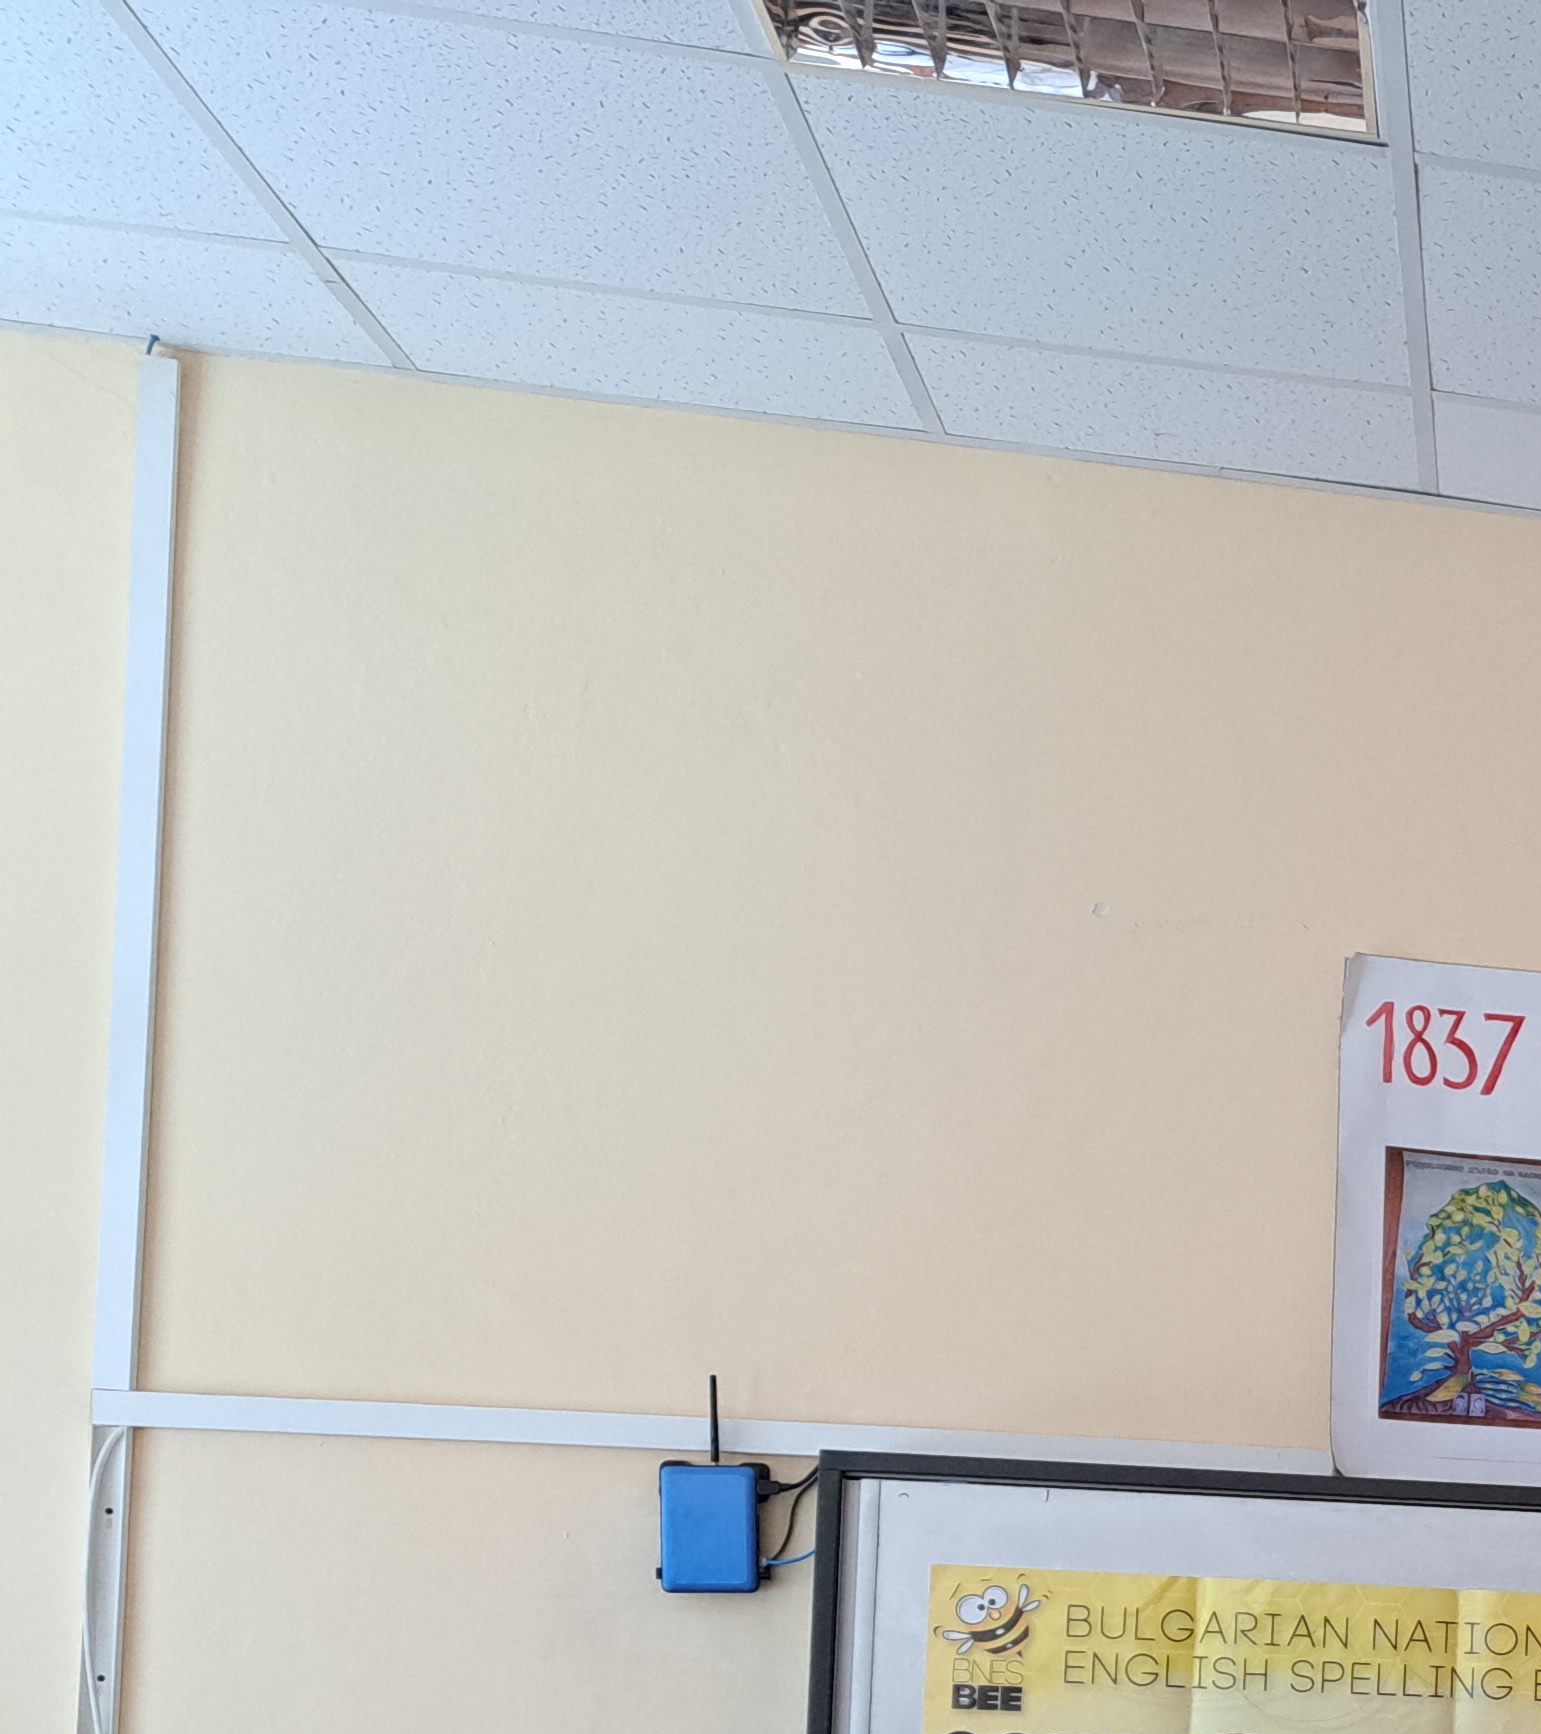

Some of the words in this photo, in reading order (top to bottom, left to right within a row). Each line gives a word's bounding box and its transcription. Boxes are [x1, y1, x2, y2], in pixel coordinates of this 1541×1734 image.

[1365, 1001, 1527, 1096] 1837
[1064, 1604, 1352, 1652] BULGARIAN
[951, 1657, 1025, 1686] BNES
[1063, 1650, 1269, 1694] ENGLISH
[1290, 1660, 1514, 1699] SPELLING
[950, 1684, 1024, 1712] BEE
